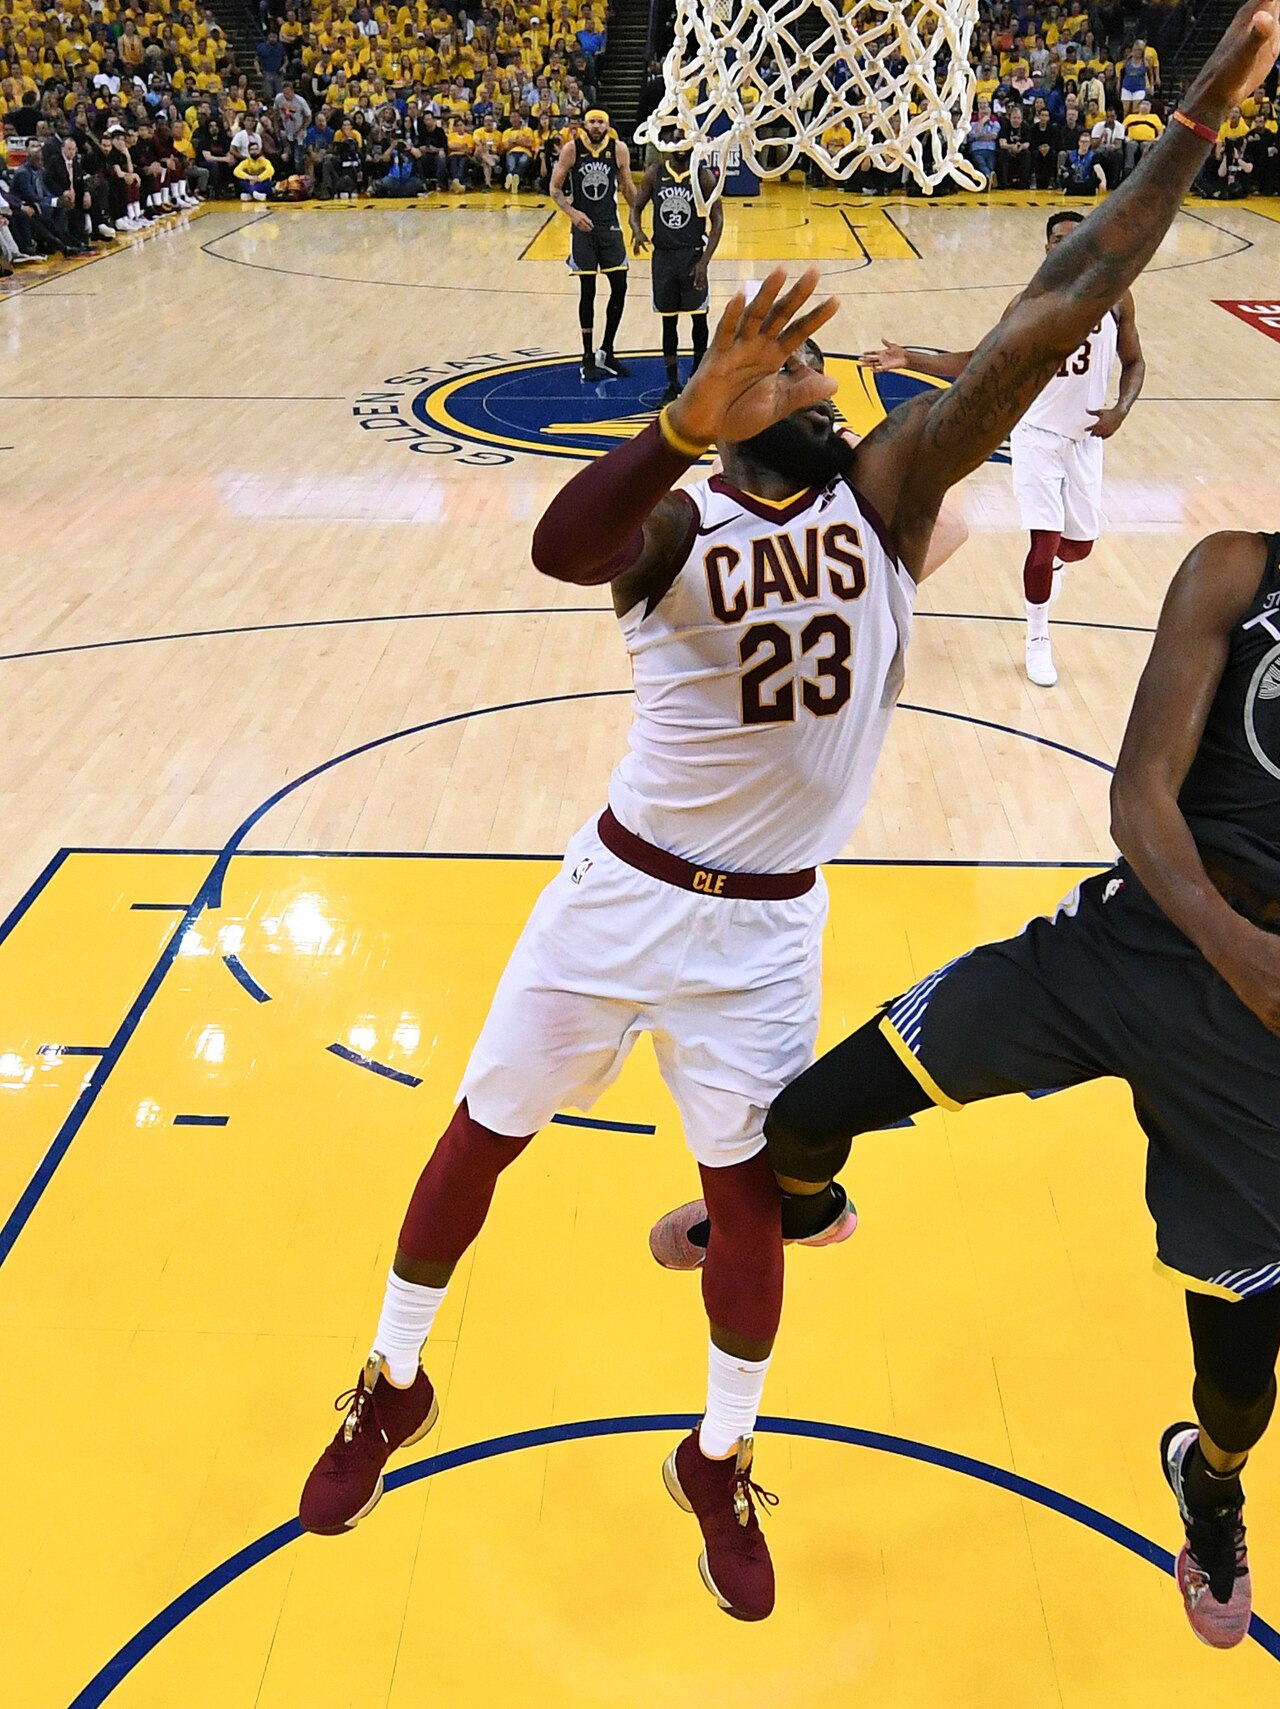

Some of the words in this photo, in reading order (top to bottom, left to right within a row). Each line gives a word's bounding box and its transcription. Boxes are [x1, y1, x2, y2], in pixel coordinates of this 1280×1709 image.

[577, 161, 611, 175] TOWN
[593, 187, 599, 198] 1
[657, 186, 694, 201] TOWN
[668, 214, 682, 226] 23
[384, 347, 560, 386] STATE
[352, 392, 515, 466] GOLDEN
[702, 521, 867, 625] CAVS
[737, 612, 852, 726] 23
[692, 871, 727, 894] CLE
